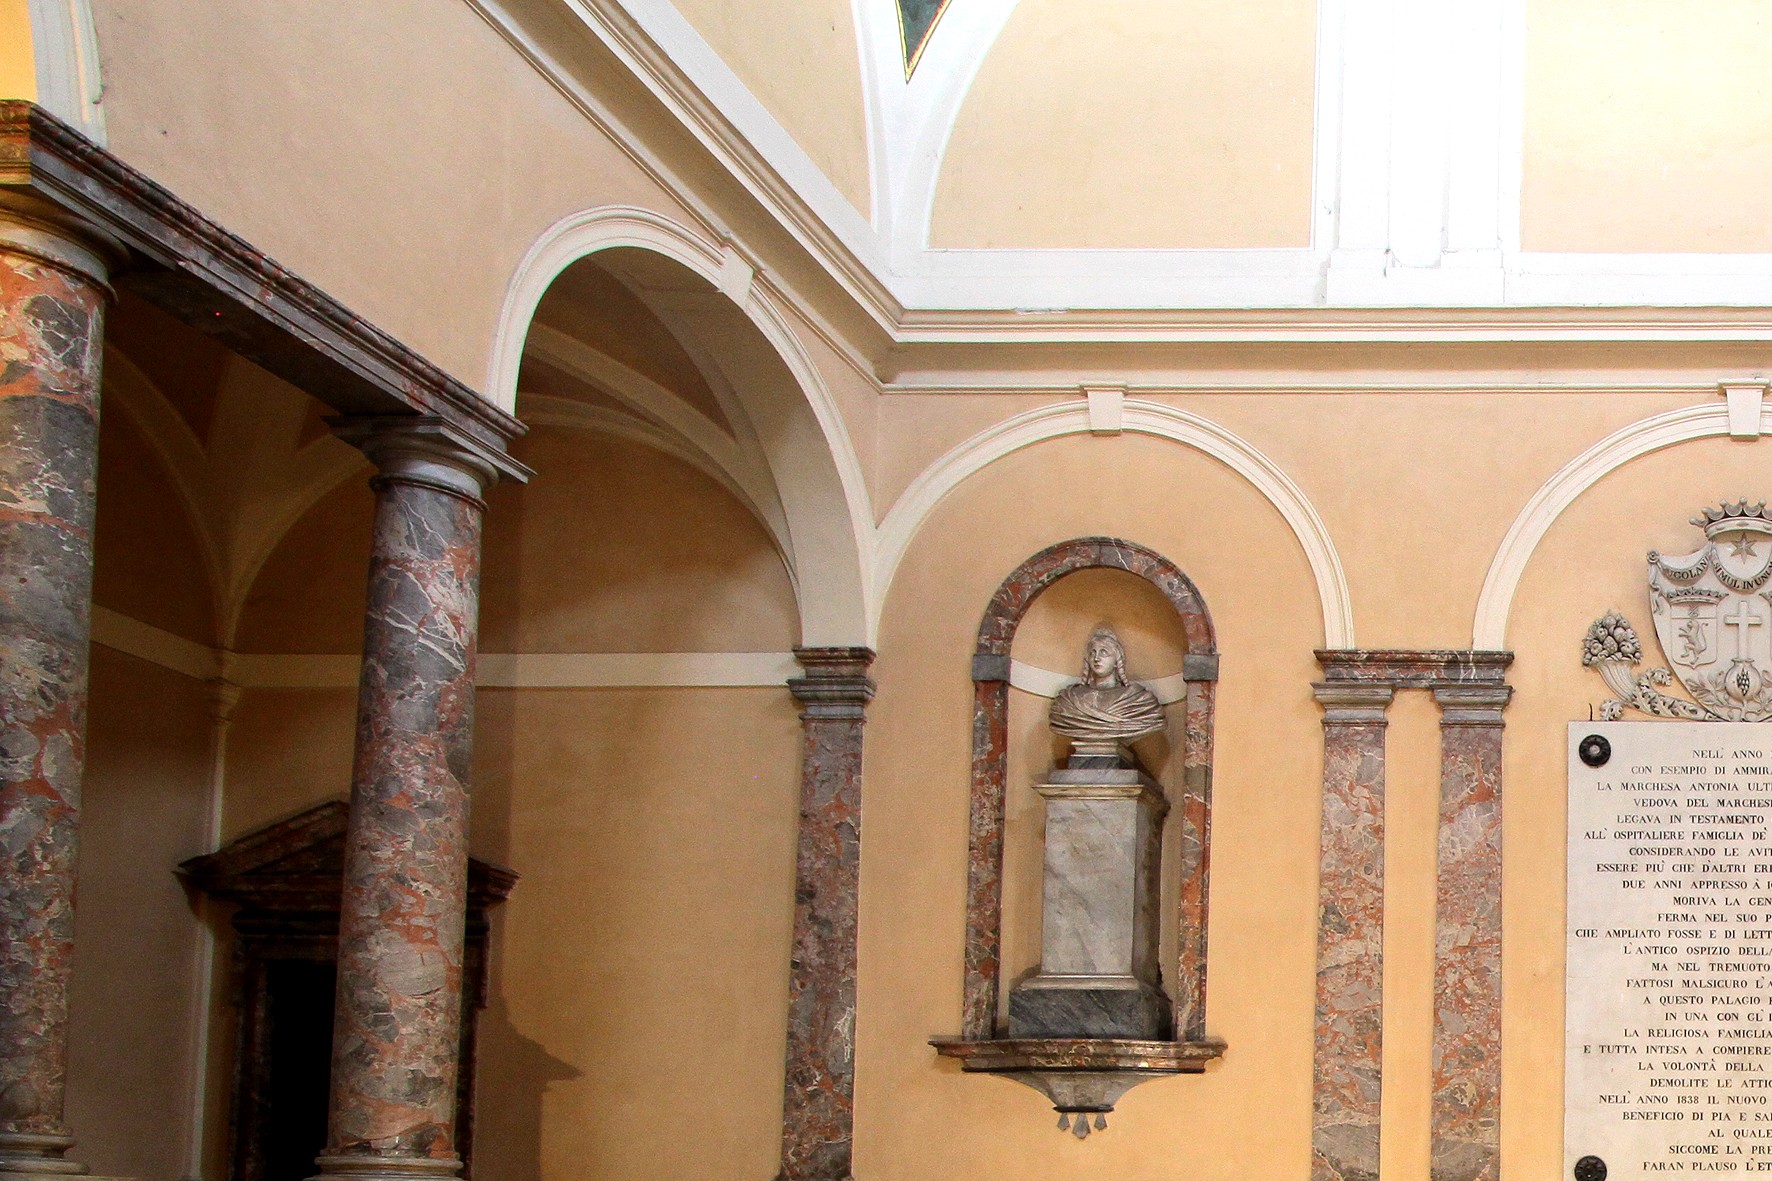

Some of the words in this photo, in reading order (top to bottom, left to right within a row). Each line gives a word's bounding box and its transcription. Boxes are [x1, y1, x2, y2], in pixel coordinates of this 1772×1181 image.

[1731, 749, 1763, 759] ANNO
[1630, 765, 1653, 775] CON
[1660, 765, 1707, 775] ESEMPIO
[1714, 765, 1726, 775] DI
[1597, 781, 1613, 792] LA
[1620, 781, 1682, 792] MARCHESA
[1688, 782, 1739, 792] ANTONIA
[1632, 798, 1679, 808] VEDOVA
[1686, 798, 1709, 808] DEL
[1616, 814, 1661, 824] LEGAVA
[1669, 814, 1682, 824] IN
[1688, 815, 1765, 825] TESTAMENTO
[1613, 831, 1685, 841] OSPITALIERE
[1691, 831, 1745, 841] FAMIGLIA
[1596, 863, 1639, 873] ESSERE
[1671, 864, 1695, 873] CHE
[1673, 897, 1717, 906] MORIVA
[1724, 897, 1741, 907] LA
[1685, 946, 1731, 956] OSPIZIO
[1651, 963, 1669, 972] MA
[1676, 963, 1701, 972] NEL
[1708, 963, 1771, 973] TREMUOTO
[1664, 1012, 1677, 1021] IN
[1684, 1012, 1709, 1022] UNA
[1716, 1013, 1740, 1022] CON
[1637, 1061, 1655, 1071] LA
[1725, 1062, 1765, 1072] DELLA
[1622, 1111, 1685, 1121] BENEFICIO
[1691, 1111, 1704, 1121] DI
[1711, 1111, 1732, 1122] PIA
[1739, 1112, 1748, 1122] E
[1642, 1161, 1685, 1171] FARAN
[1691, 1161, 1738, 1172] PLAUSO
